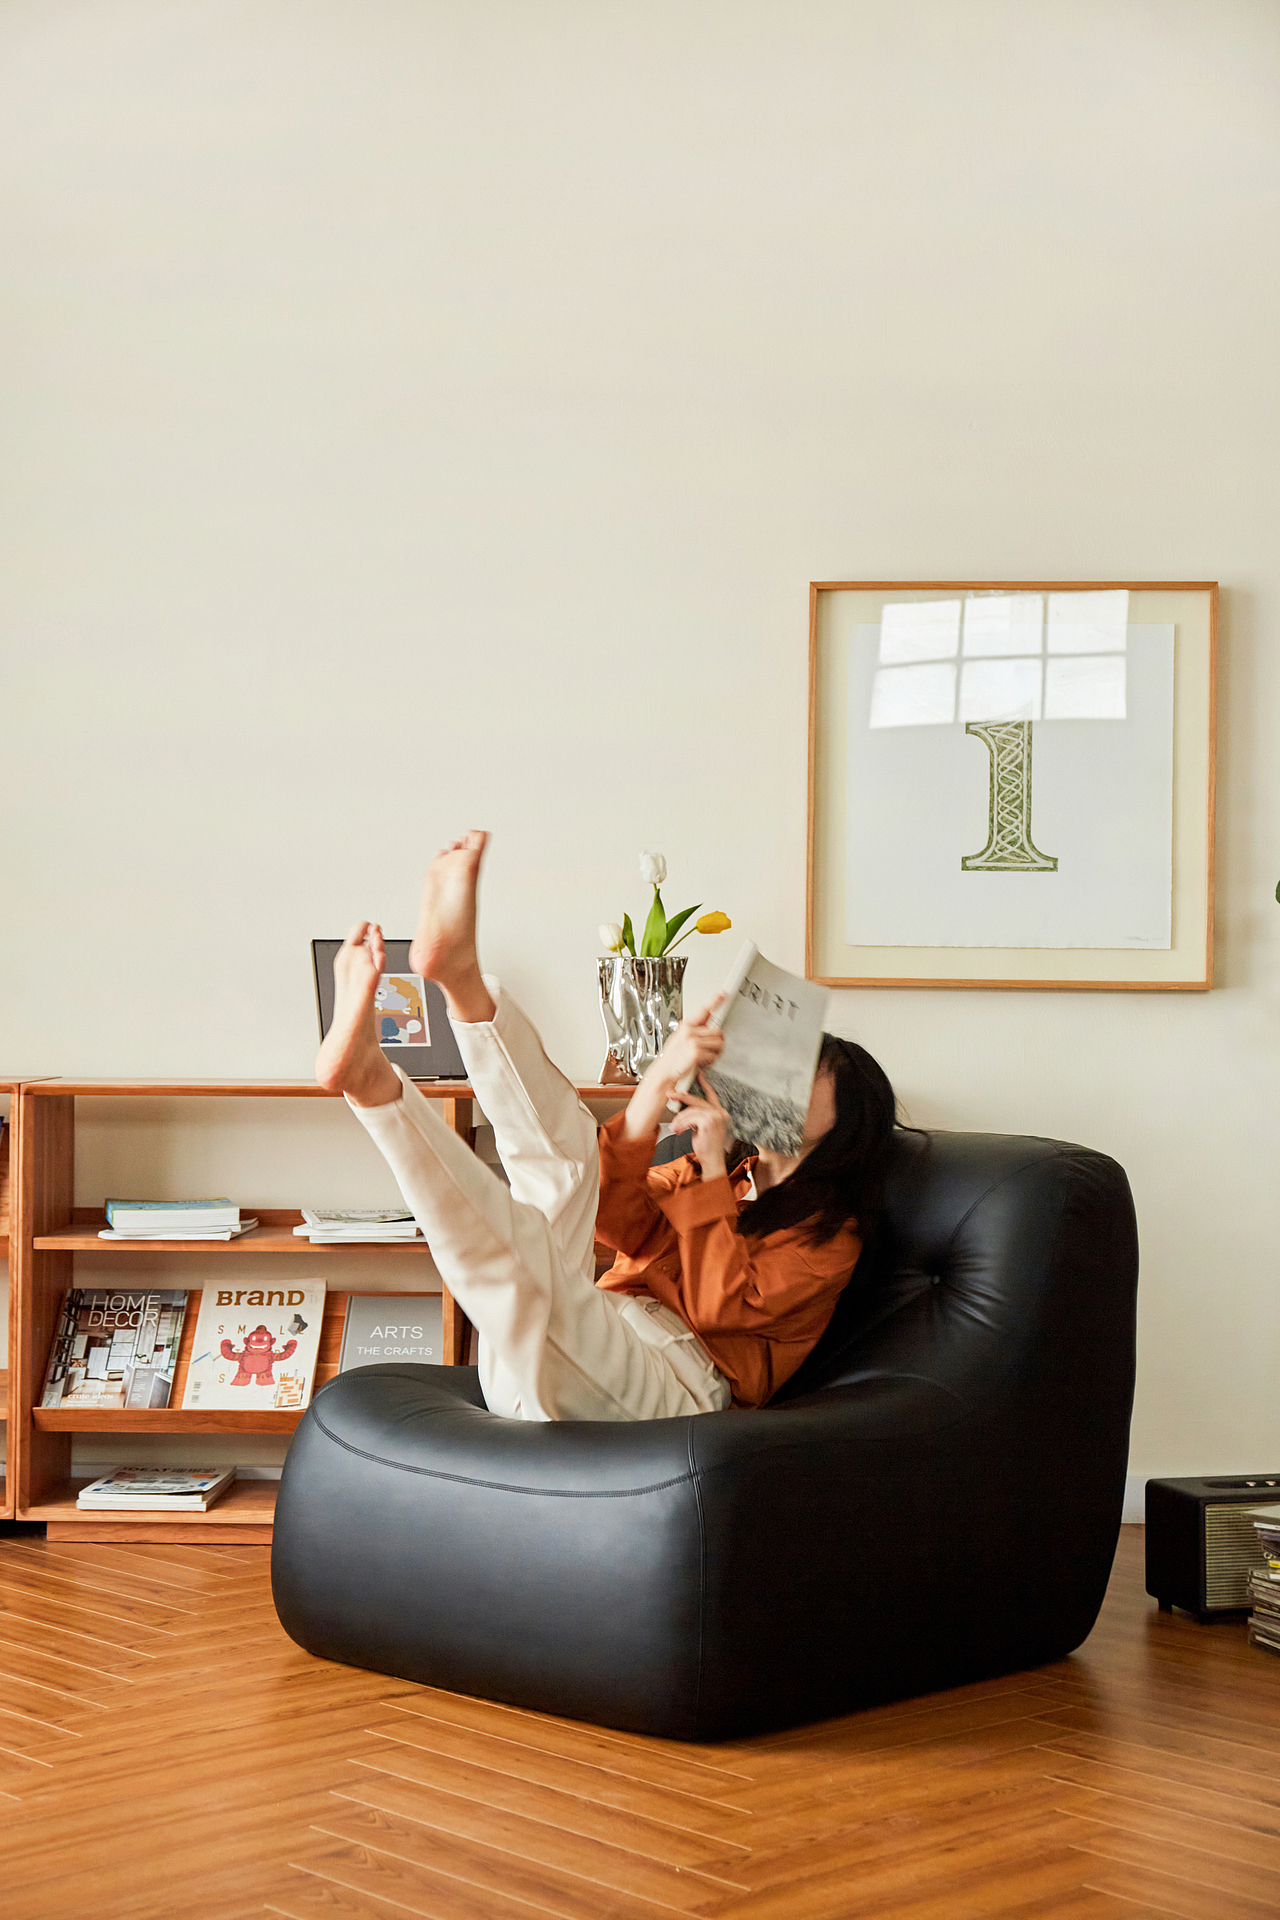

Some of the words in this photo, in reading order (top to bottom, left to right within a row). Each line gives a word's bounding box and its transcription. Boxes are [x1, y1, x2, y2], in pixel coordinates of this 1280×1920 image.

[91, 1295, 161, 1312] HOME
[88, 1311, 159, 1328] DECOR
[369, 1325, 424, 1340] ARTS
[356, 1346, 381, 1356] THE
[383, 1346, 434, 1357] CRAFTS
[92, 1392, 114, 1400] ideas
